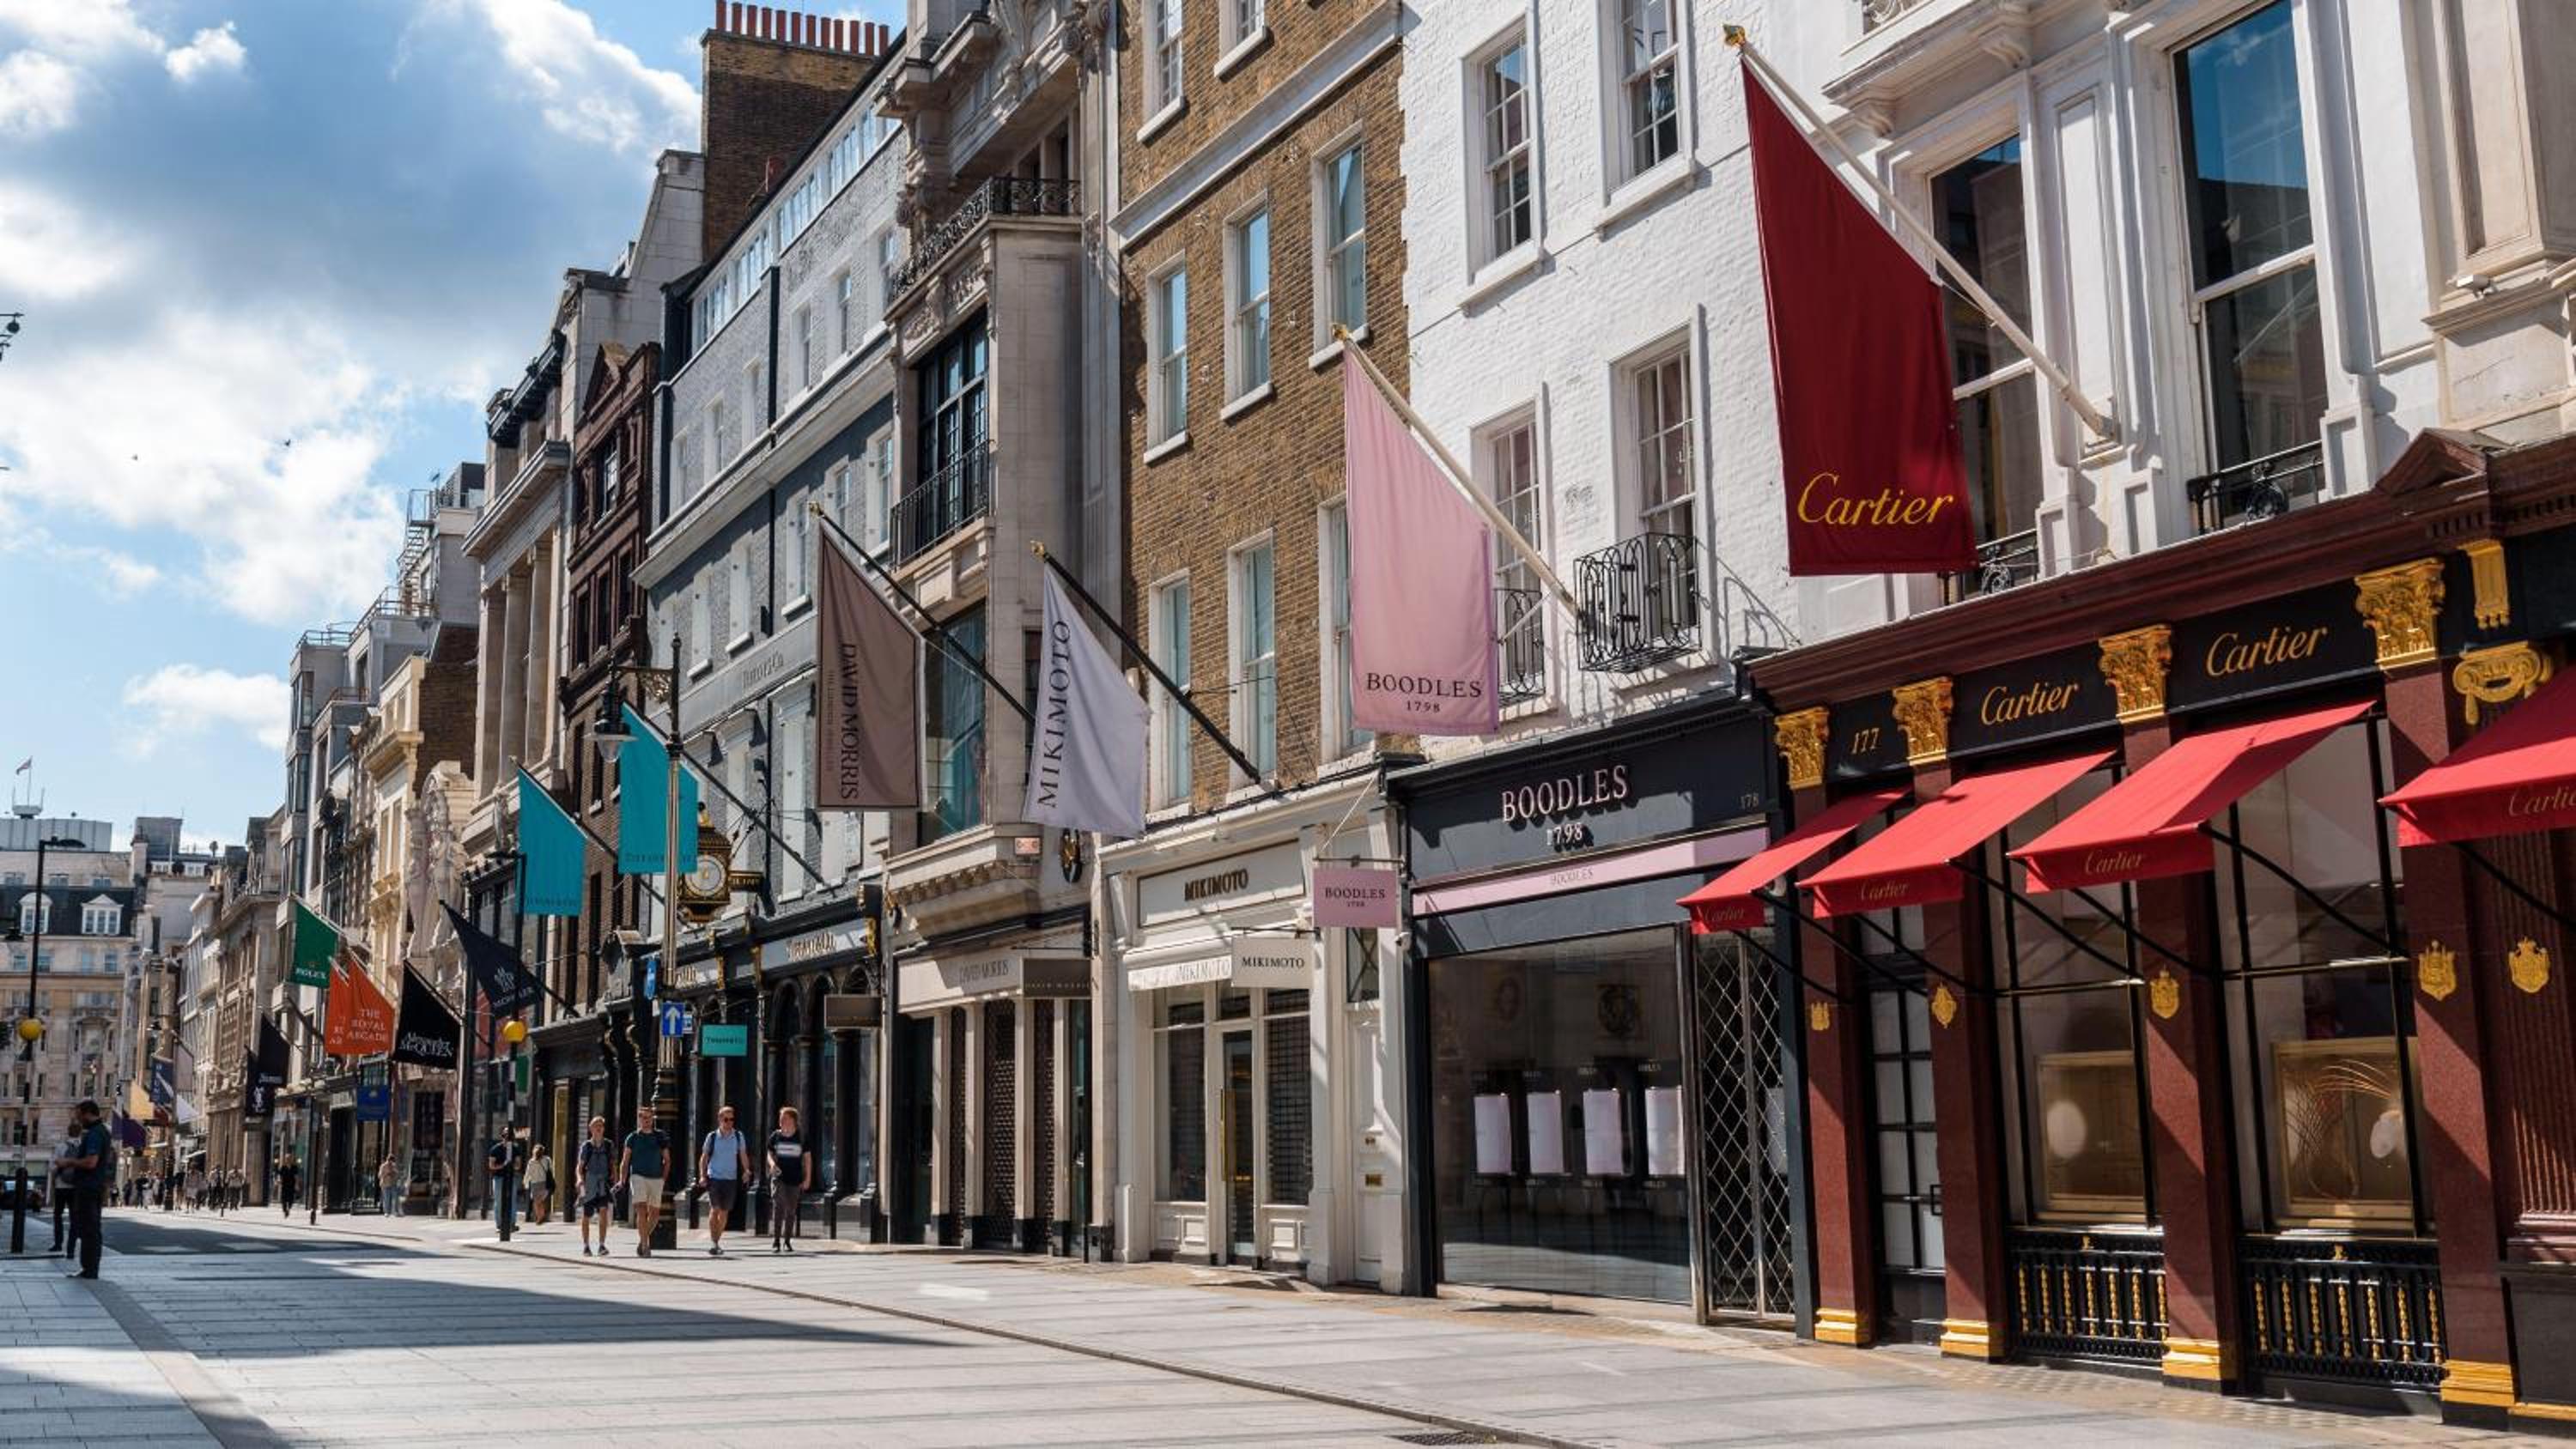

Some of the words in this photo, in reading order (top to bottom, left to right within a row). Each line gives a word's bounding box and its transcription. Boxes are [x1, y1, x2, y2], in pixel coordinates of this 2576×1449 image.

[1797, 472, 1953, 525] Cartier
[2206, 627, 2329, 676] Cartier
[841, 643, 858, 709] DAVID
[1366, 672, 1482, 698] BOODLES
[1037, 620, 1071, 808] MIKIMOTO
[1406, 700, 1441, 712] 1798
[1980, 682, 2079, 726] Cartier
[1851, 727, 1880, 754] 177
[841, 712, 858, 800] MORRIS
[1501, 765, 1628, 822] BOODLES
[1546, 822, 1583, 846] 1798
[2085, 849, 2143, 875] Cartier
[1184, 868, 1249, 902] MIKIMOTO
[1324, 887, 1386, 900] BOODLES
[1860, 878, 1910, 902] Cartier
[1242, 956, 1305, 968] MIKIMOTO
[351, 1019, 386, 1031] ROYAL
[359, 1009, 380, 1018] THE
